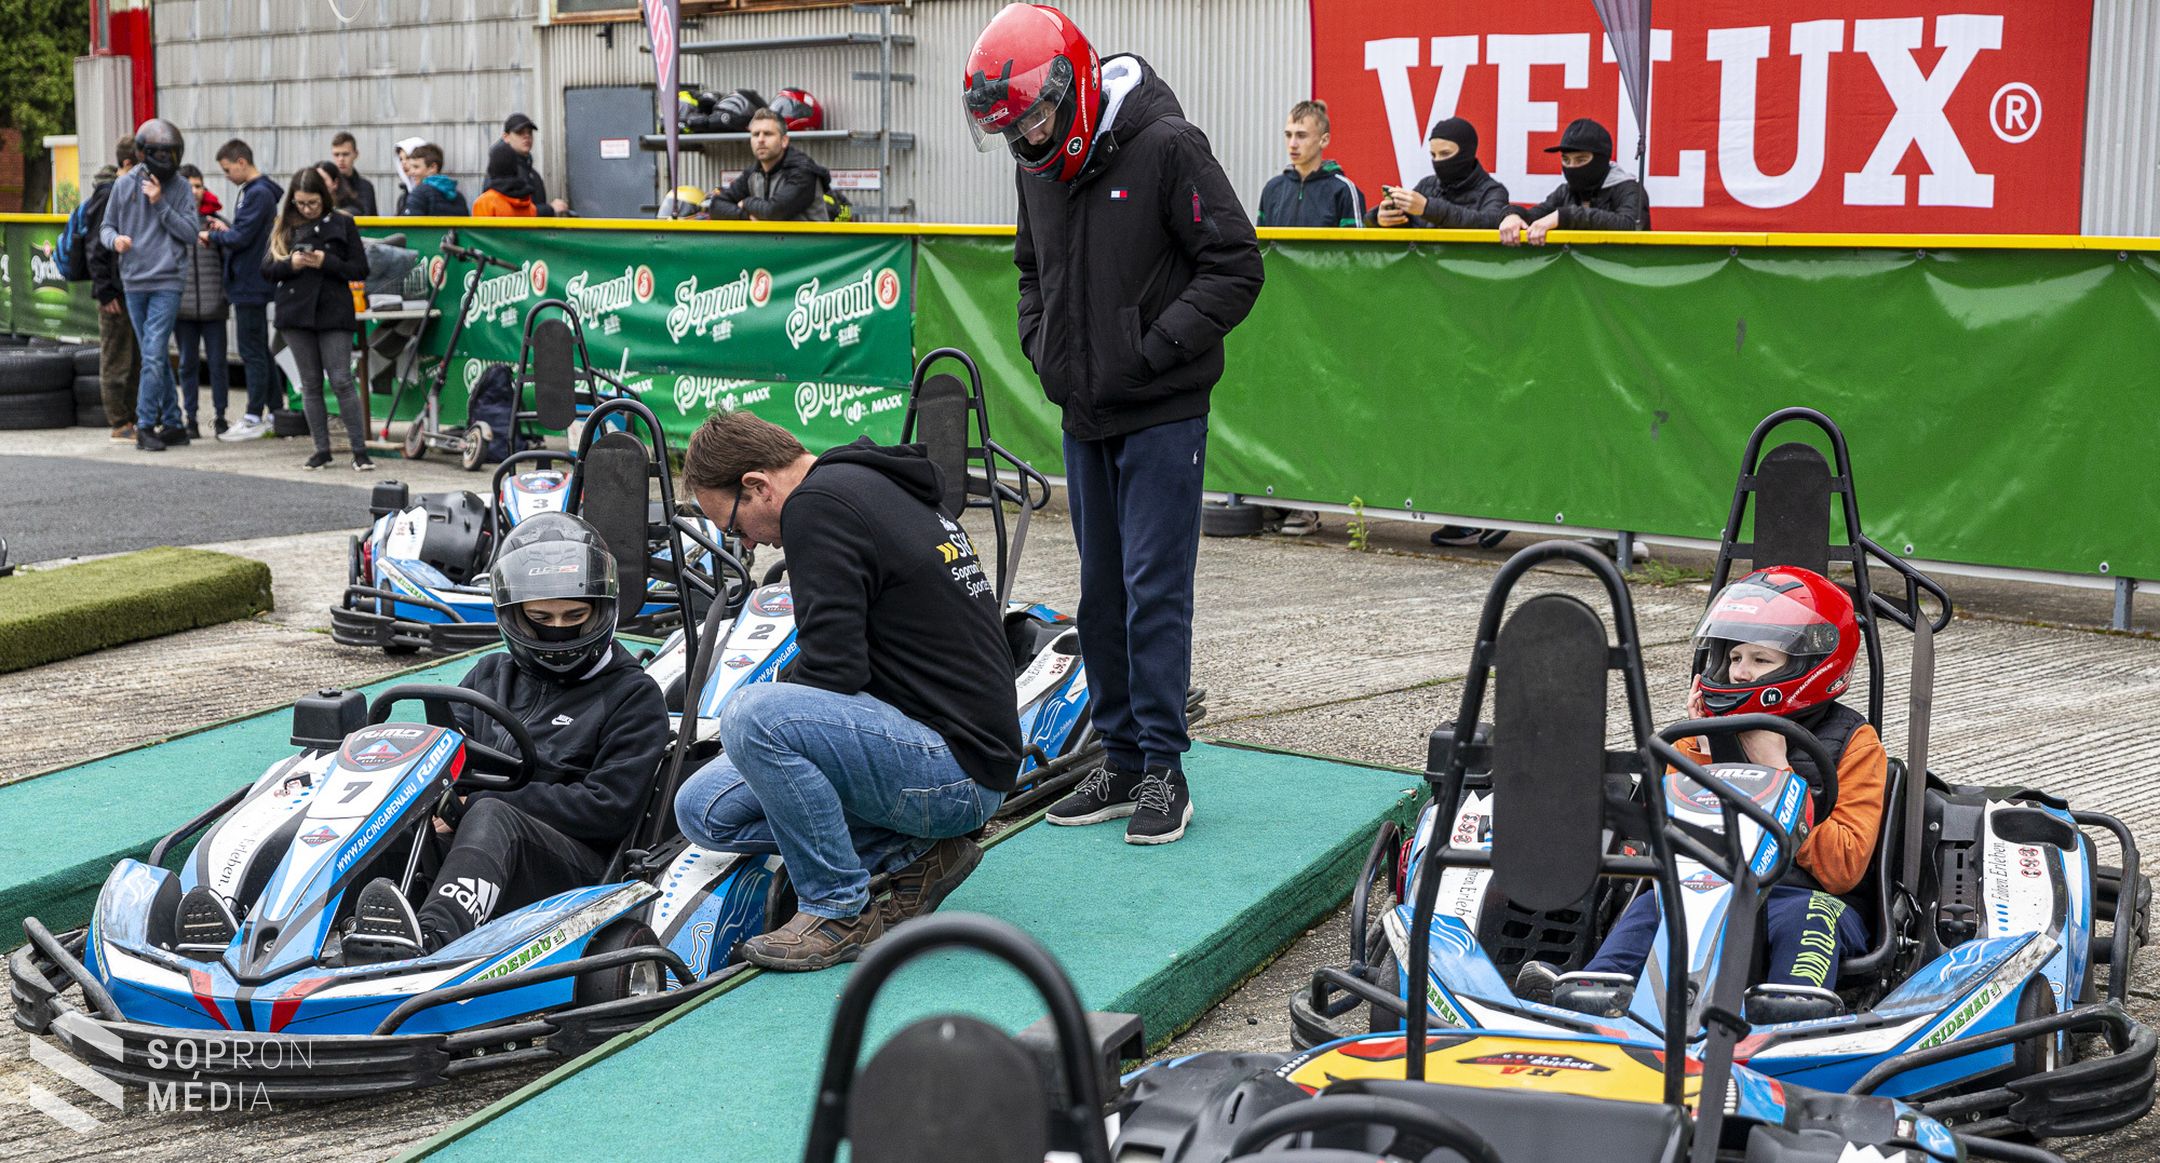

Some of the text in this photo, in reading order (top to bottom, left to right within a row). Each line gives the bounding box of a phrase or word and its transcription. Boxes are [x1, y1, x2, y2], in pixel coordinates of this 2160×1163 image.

[1364, 14, 2004, 208] VELUX
[563, 265, 634, 330] Soproni
[666, 268, 750, 344] Soproni
[785, 268, 873, 350] Soproni
[871, 393, 903, 414] MAXX
[532, 498, 549, 509] 3
[747, 623, 776, 640] 2
[338, 781, 373, 804] 7
[336, 781, 417, 873] WWW.RACINGARENA.HU
